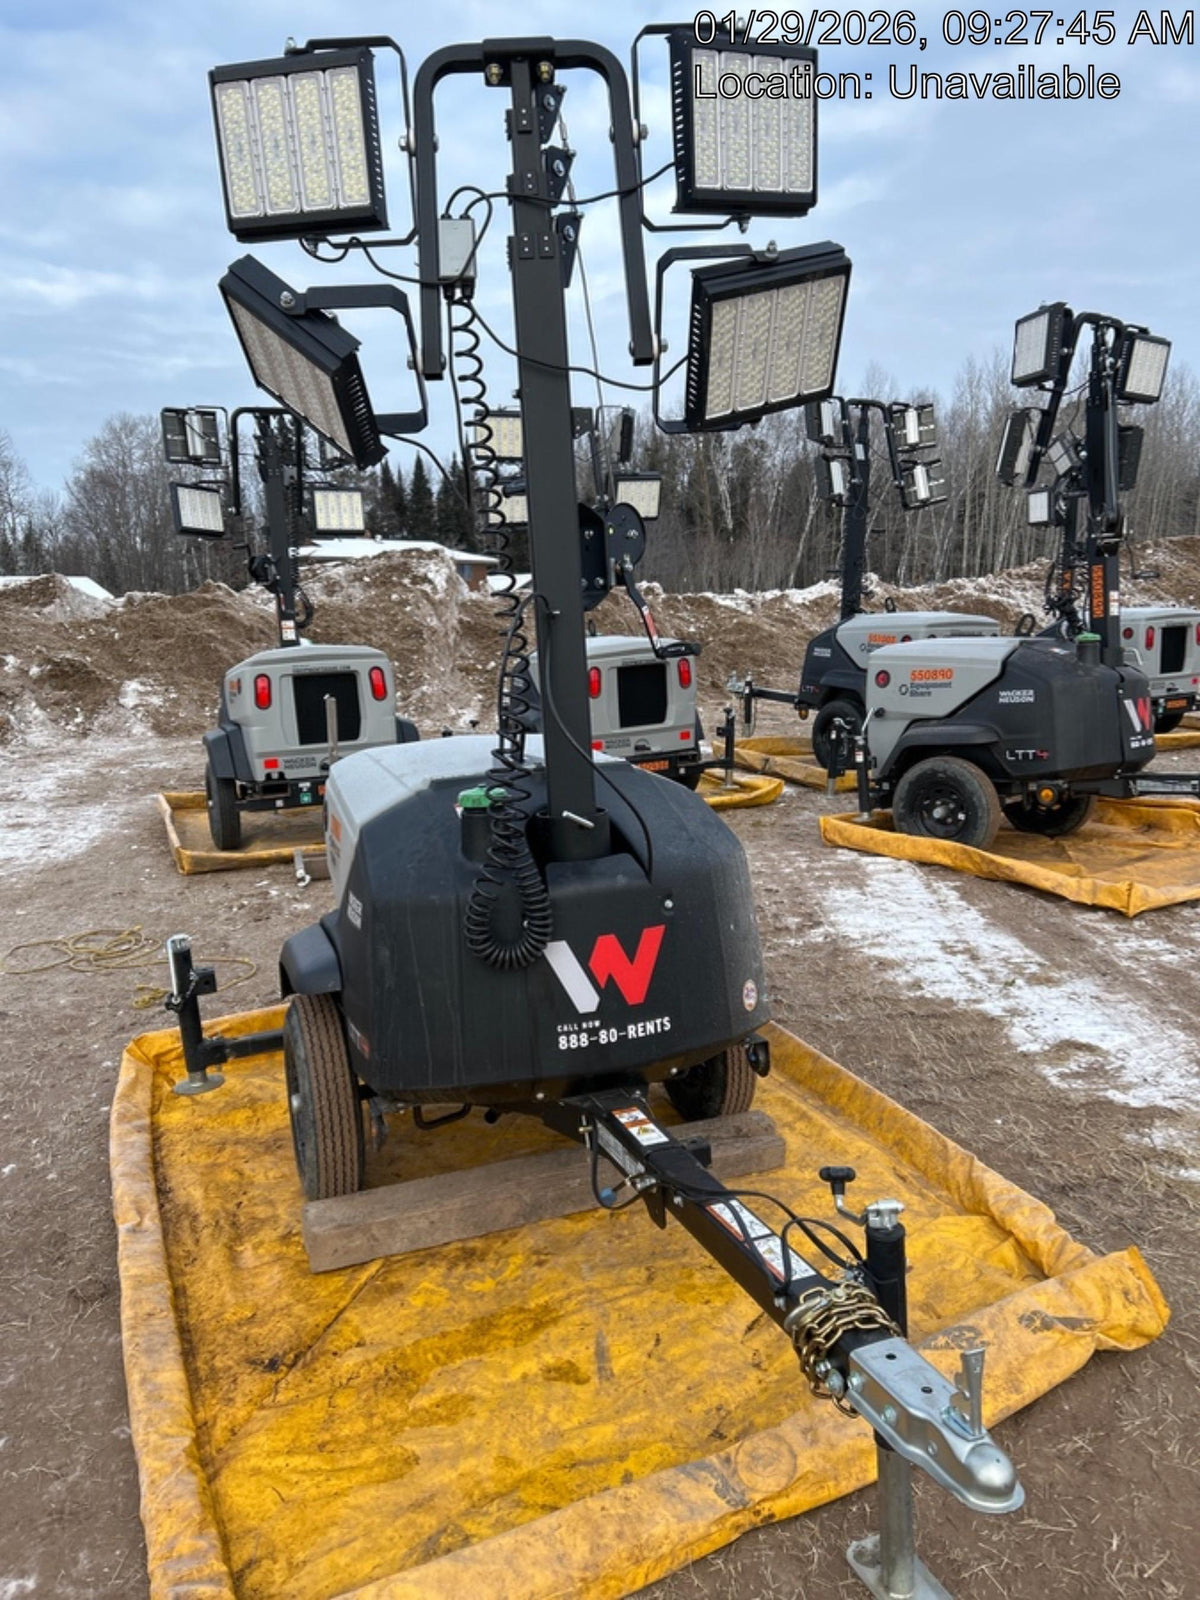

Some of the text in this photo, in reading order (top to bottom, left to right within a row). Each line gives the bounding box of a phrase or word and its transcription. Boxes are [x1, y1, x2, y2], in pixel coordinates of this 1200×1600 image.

[1006, 750, 1048, 760] LTT4
[557, 1020, 600, 1032] CALL NOW
[558, 1016, 672, 1050] 888-80-RENTS
